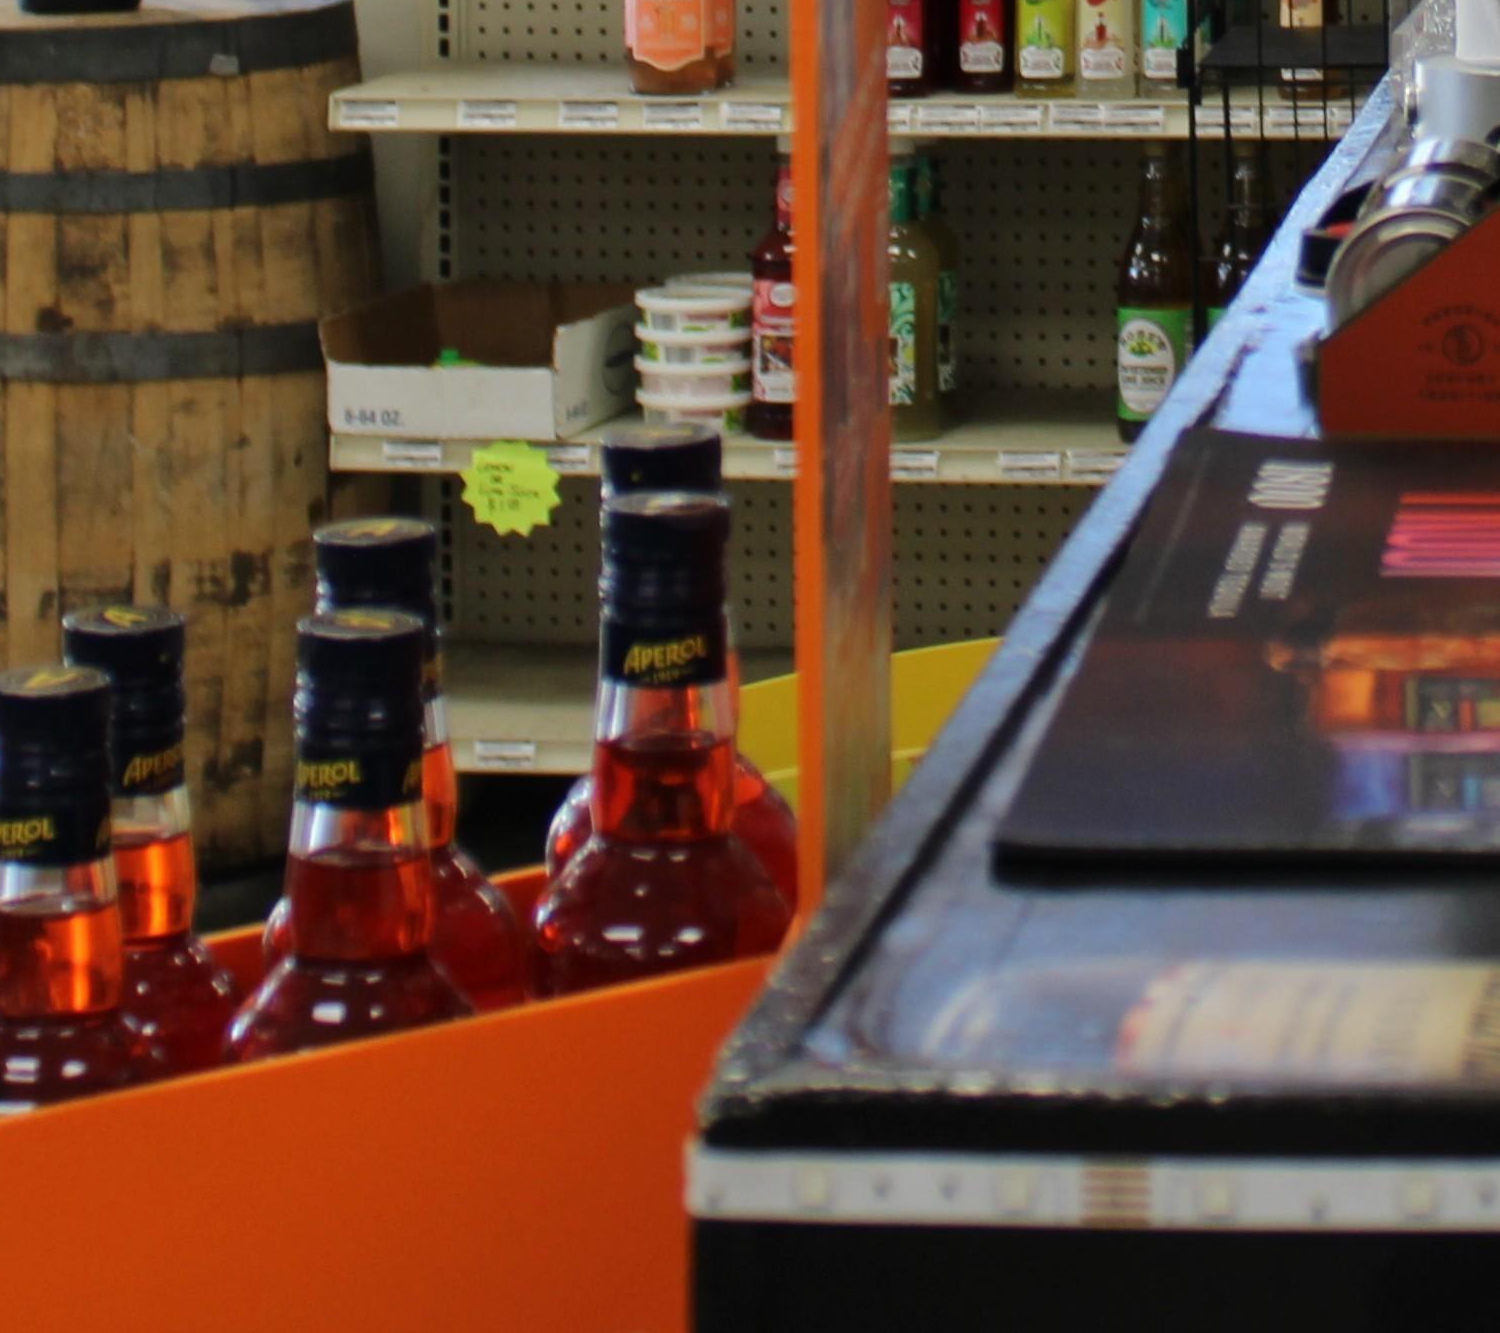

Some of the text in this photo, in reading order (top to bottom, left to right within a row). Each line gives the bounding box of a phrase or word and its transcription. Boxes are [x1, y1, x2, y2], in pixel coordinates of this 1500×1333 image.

[1247, 461, 1334, 510] 1800
[622, 635, 707, 675] APEROL
[300, 760, 361, 787] PEROL
